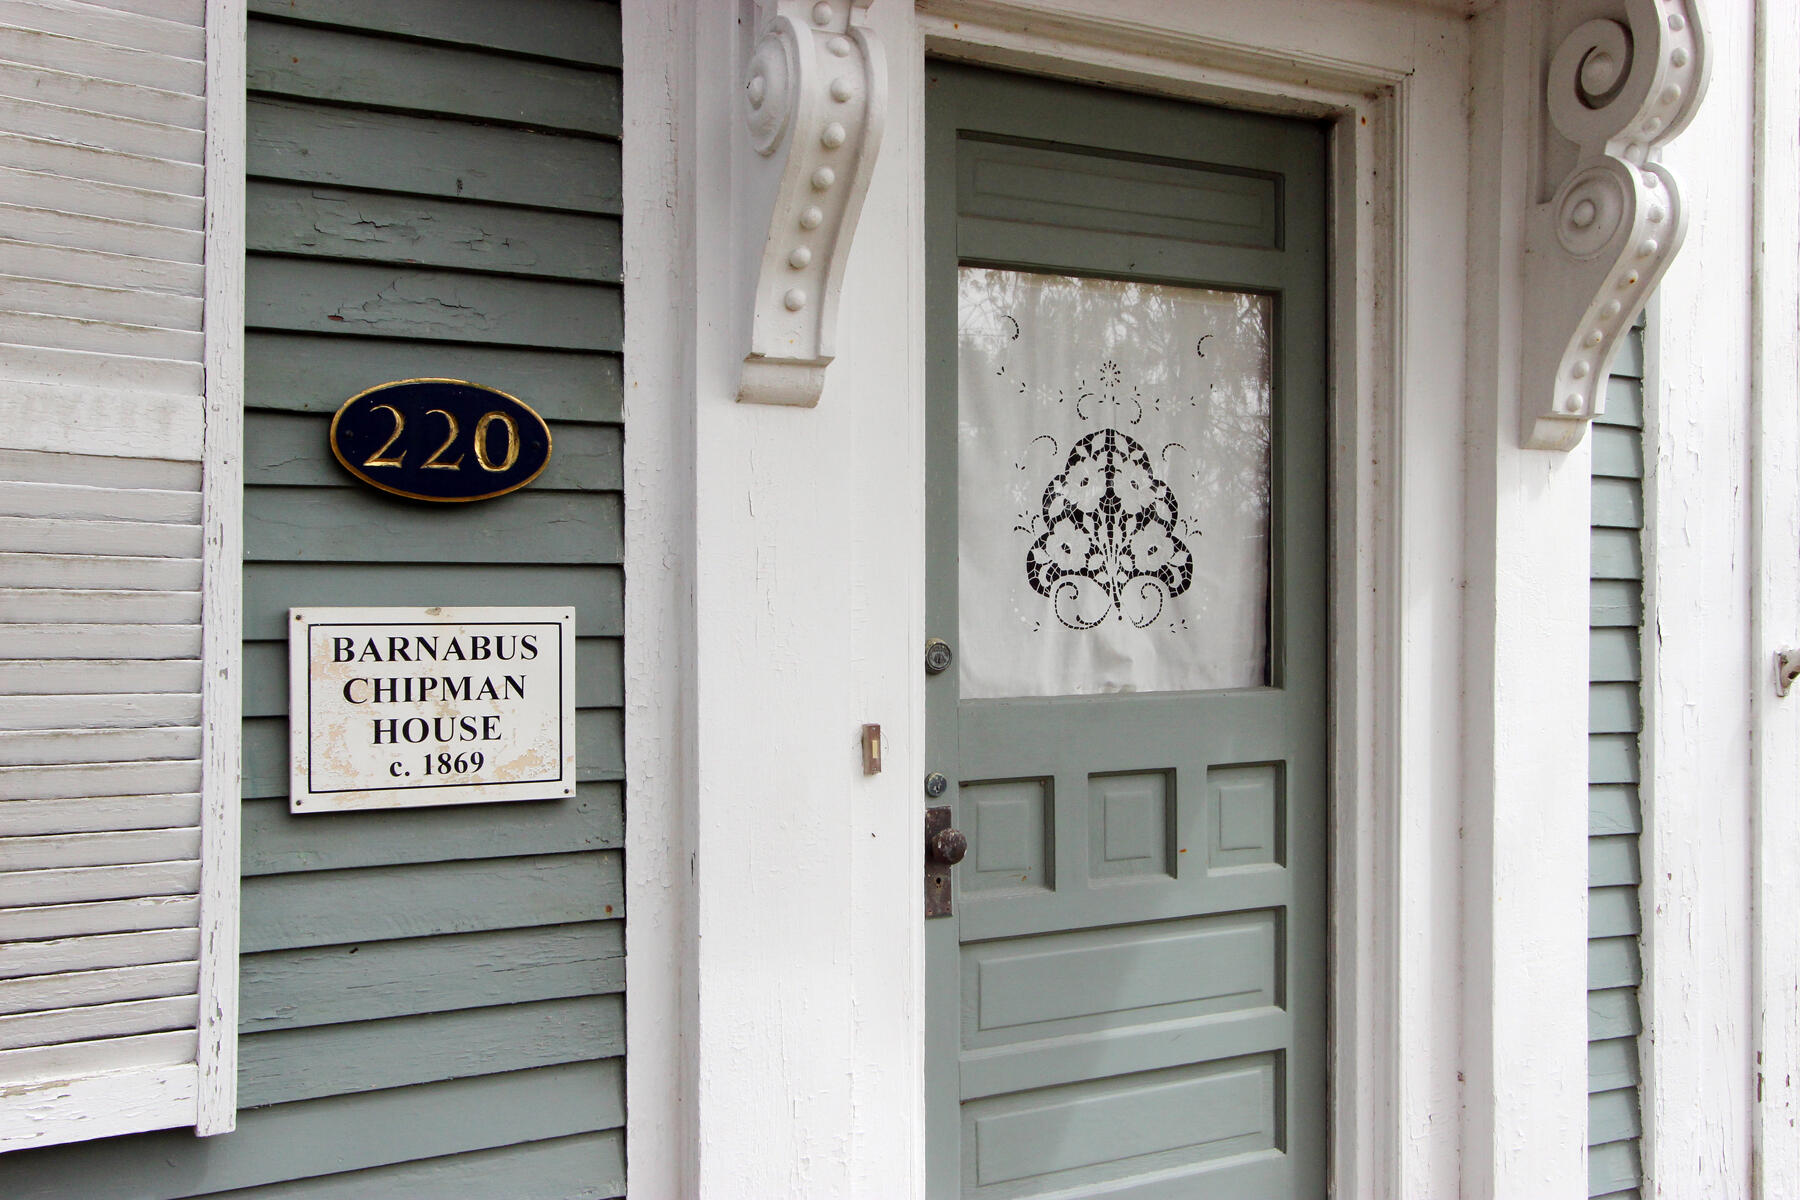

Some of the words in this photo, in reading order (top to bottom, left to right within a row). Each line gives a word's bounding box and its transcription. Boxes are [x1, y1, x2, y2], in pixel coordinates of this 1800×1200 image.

[363, 403, 520, 472] 220
[332, 634, 539, 663] BARNABUS
[343, 674, 528, 704] CHIPMAN
[372, 715, 502, 745] HOUSE
[389, 760, 411, 777] c.
[423, 751, 485, 776] 1869
